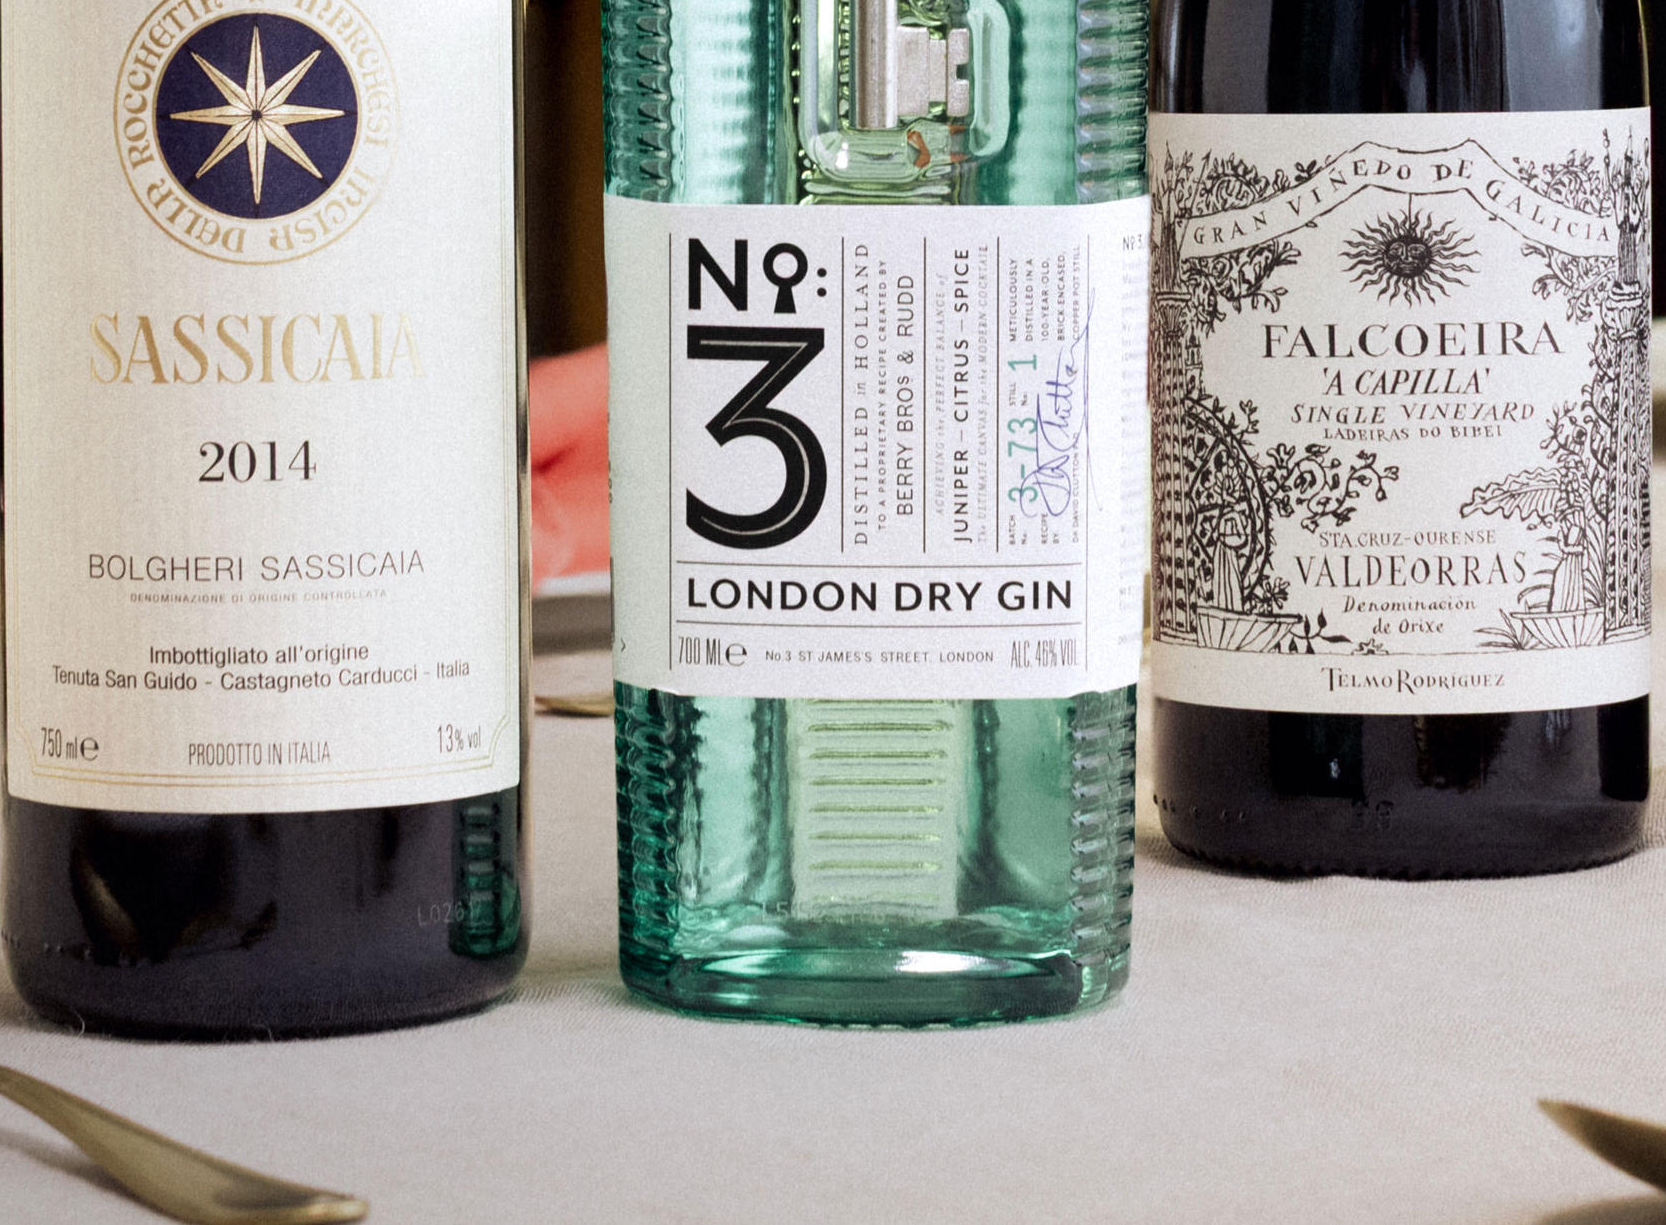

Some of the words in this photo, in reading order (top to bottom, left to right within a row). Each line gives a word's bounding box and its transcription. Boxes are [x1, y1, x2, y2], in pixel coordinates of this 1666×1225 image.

[1194, 212, 1268, 244] GRAN
[1435, 158, 1474, 181] DE
[1485, 179, 1609, 242] GALICIA
[878, 260, 887, 275] BY
[953, 249, 970, 313] SPICE
[1009, 258, 1017, 342] METICULOUSLY
[1073, 276, 1081, 297] POT
[855, 244, 869, 370] HOLLAND
[878, 282, 887, 342] CREATED
[897, 275, 914, 337] RUDD
[935, 292, 945, 352] BALANCE
[1025, 286, 1034, 342] DISTILLED
[90, 310, 427, 385] SASSICAIA
[1262, 321, 1565, 358] FALCOEIRA
[878, 349, 887, 395] RECIPE
[897, 350, 914, 364] &
[1007, 354, 1037, 372] 1
[855, 382, 867, 396] in
[935, 357, 946, 414] PERFECT
[953, 339, 969, 423] CITRUS
[1009, 382, 1017, 407] STILL
[1323, 368, 1347, 396] 'A
[1355, 368, 1490, 396] CAPILLA'
[1291, 403, 1387, 424] SINGLE
[1401, 401, 1534, 422] VINEYARD
[686, 325, 827, 549] 3
[878, 402, 887, 493] PROPRIETARY
[1323, 427, 1409, 442] LADEIRAS
[1419, 428, 1441, 438] DO
[1451, 425, 1503, 438] BIBEI
[198, 439, 318, 483] 2014
[855, 407, 869, 546] DISTILLED
[1007, 416, 1038, 503] 3-73
[897, 443, 914, 516] BERRY
[935, 442, 946, 516] ACHIEVING
[953, 449, 973, 543] JUNIPER
[977, 460, 989, 520] ULTIMATE
[878, 514, 887, 530] TO
[1009, 514, 1017, 546] BATCH
[1041, 512, 1049, 544] RECIPE
[1053, 532, 1060, 544] BY
[89, 554, 243, 582] BOLGHERI
[261, 549, 424, 581] SASSICAIA
[1295, 550, 1527, 587] VALDEORRAS
[130, 593, 224, 604] DENOMINAZIONE
[231, 594, 243, 603] DI
[249, 593, 297, 603] ORIGINE
[303, 589, 387, 602] CONTROLLATA
[688, 577, 877, 612] LONDON
[894, 580, 983, 612] DRY
[997, 579, 1072, 610] GIN
[1373, 618, 1391, 635] de
[1399, 618, 1444, 635] Orixe
[150, 646, 268, 668] Imbottigliato
[275, 644, 369, 666] all'origine
[678, 636, 701, 665] 700
[799, 650, 813, 662] ST
[818, 650, 873, 663] JAMES'S
[939, 650, 994, 663] LONDON
[1035, 638, 1058, 668] 46%
[1059, 638, 1079, 666] VOL
[52, 665, 100, 687] Tenuta
[105, 670, 137, 689] San
[144, 672, 197, 691] Guido
[220, 671, 331, 693] Castagneto
[339, 664, 418, 687] Carducci
[436, 659, 470, 679] Italia
[41, 727, 62, 758] 750
[188, 742, 262, 766] PRODOTTO
[267, 742, 282, 766] IN
[287, 741, 331, 765] ITALIA
[437, 724, 464, 753] 13%
[467, 726, 482, 749] vol
